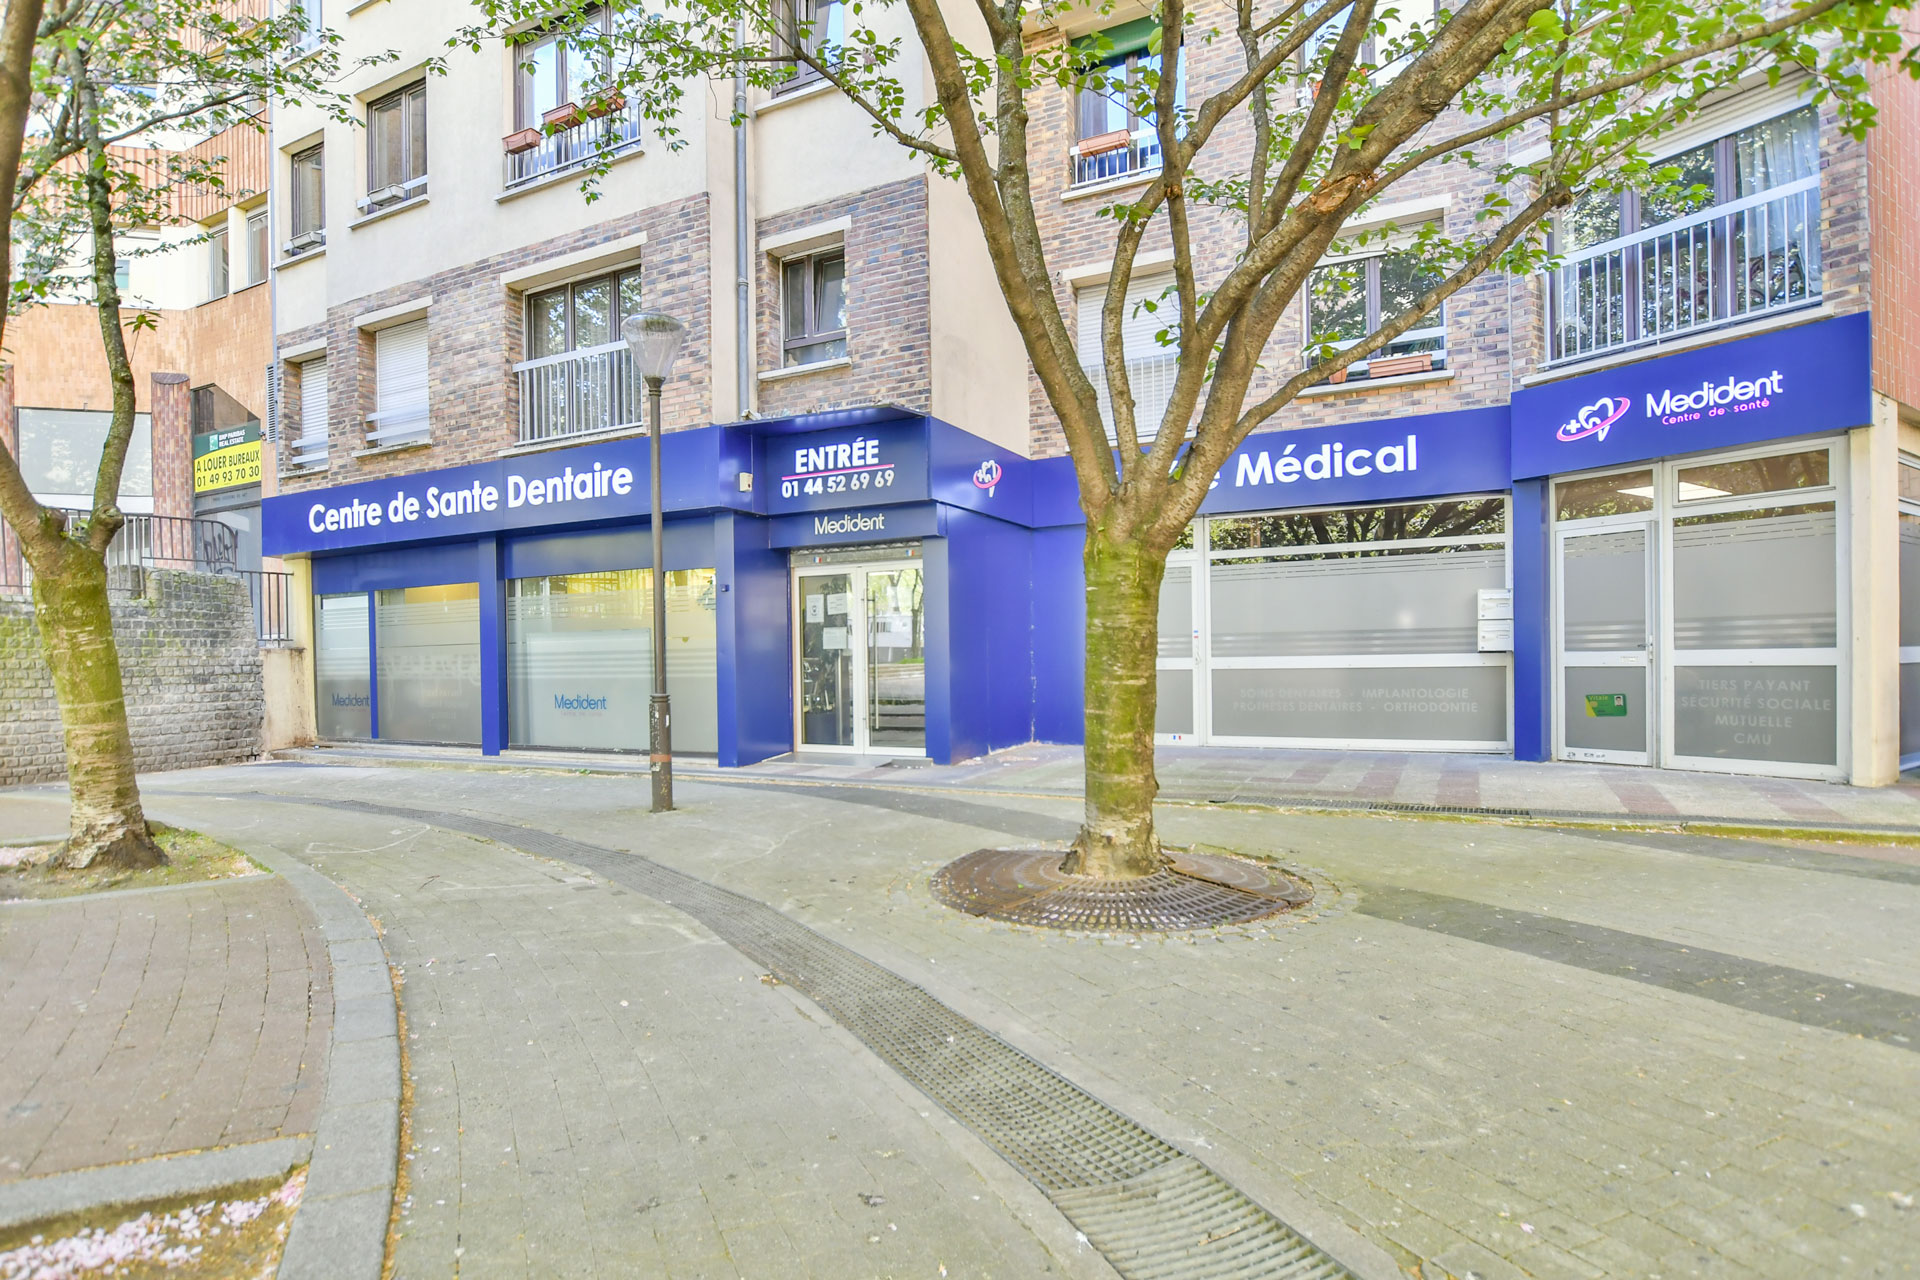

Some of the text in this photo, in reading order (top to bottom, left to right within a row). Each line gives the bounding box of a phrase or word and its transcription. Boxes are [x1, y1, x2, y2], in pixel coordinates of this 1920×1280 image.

[1646, 370, 1784, 418] Medident
[1662, 397, 1770, 425] Centre de santé
[218, 436, 244, 448] REAL ESTATE
[196, 450, 260, 473] A LOUER BUREAUX
[794, 437, 880, 474] ENTRÉE
[1235, 434, 1418, 487] Médical
[196, 465, 260, 487] 01 49 93 70 30
[781, 469, 895, 498] 01 44 52 69 69
[308, 461, 634, 533] Centre de Sante Dentaire
[814, 513, 885, 535] Medident
[1362, 687, 1469, 698] IMPLANTOLOGIE
[1699, 679, 1811, 692] TIERS PAYANT
[332, 692, 370, 707] Medident
[554, 693, 607, 710] Medident
[1299, 701, 1363, 712] DENTAIRES
[1383, 701, 1479, 713] ORTHODONTIE
[1758, 698, 1832, 711] SOCIALE
[1715, 715, 1793, 728] MUTUELLE
[1733, 732, 1772, 745] CMU
